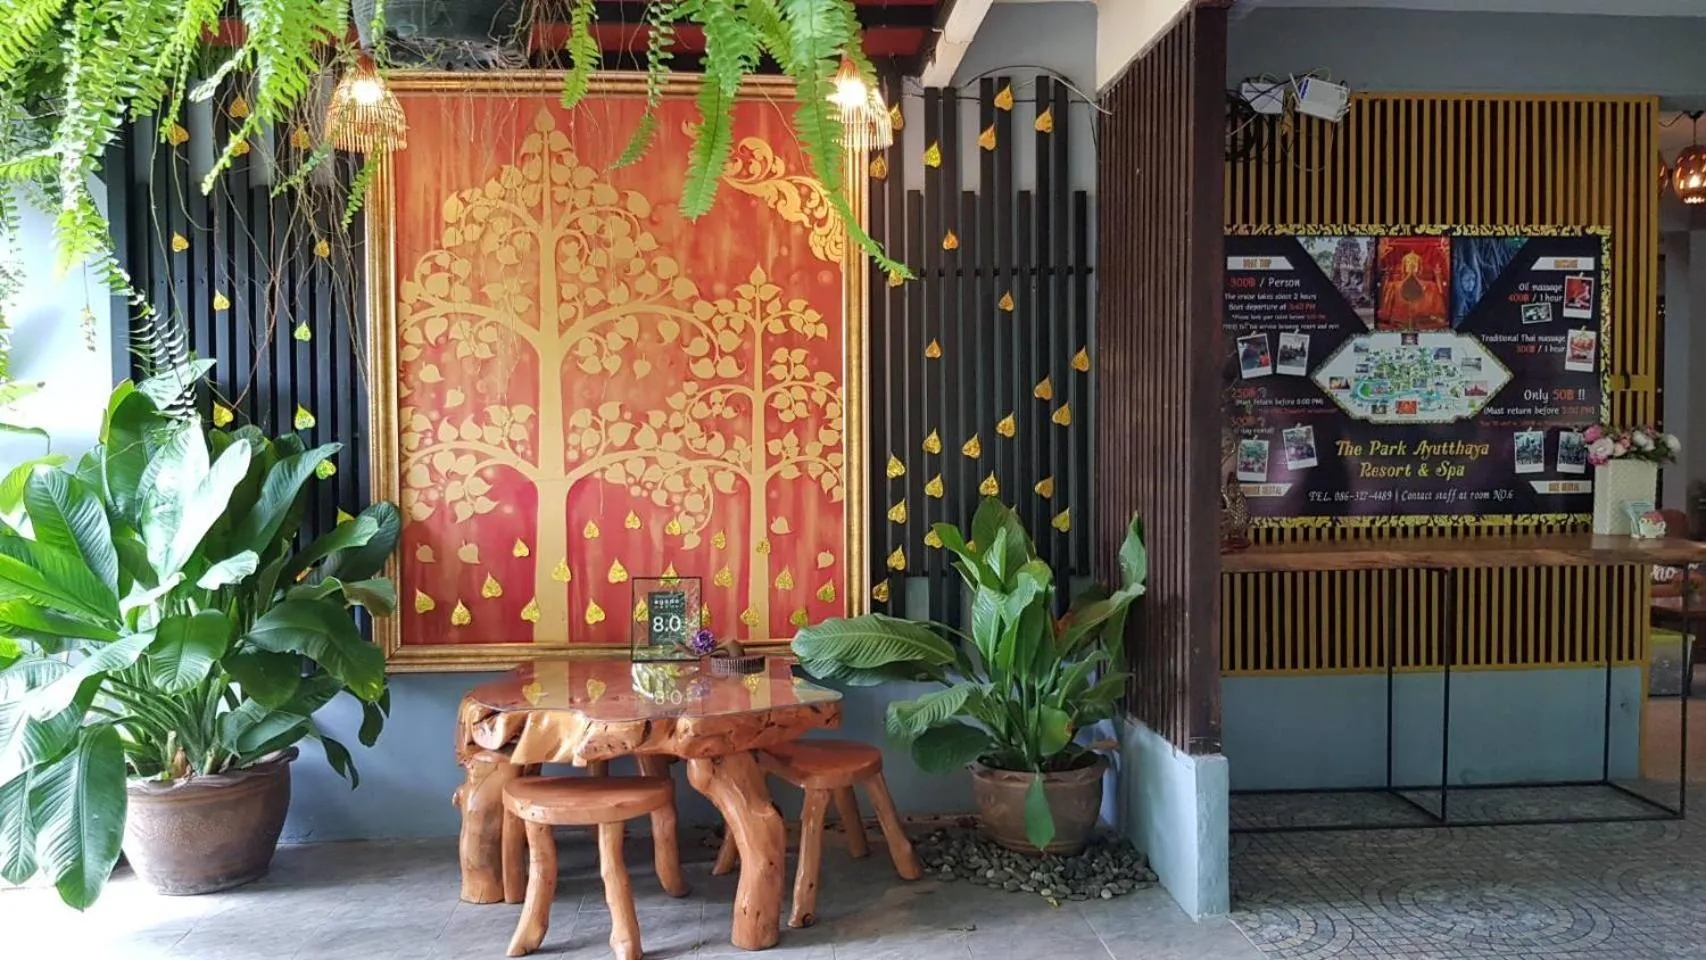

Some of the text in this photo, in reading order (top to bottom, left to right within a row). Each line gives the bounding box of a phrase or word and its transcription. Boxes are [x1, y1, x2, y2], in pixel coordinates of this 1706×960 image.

[1268, 276, 1300, 288] Person
[1518, 282, 1562, 294] Oil massage
[1545, 294, 1562, 302] hour
[1246, 303, 1278, 312] departure
[1482, 334, 1566, 344] Traditional Thai massage
[1549, 344, 1566, 353] hour
[1524, 388, 1549, 402] Only
[1274, 398, 1294, 406] before
[1484, 406, 1504, 415] (Must
[1507, 407, 1532, 415] return
[1534, 406, 1559, 416] before
[1336, 440, 1490, 460] The Park Ayutthaya
[1360, 460, 1465, 480] Resort & Spa
[1401, 489, 1432, 500] Contact
[1435, 488, 1458, 503] staff
[1459, 490, 1466, 500] at
[1470, 492, 1490, 500] room
[652, 614, 682, 632] 8.0
